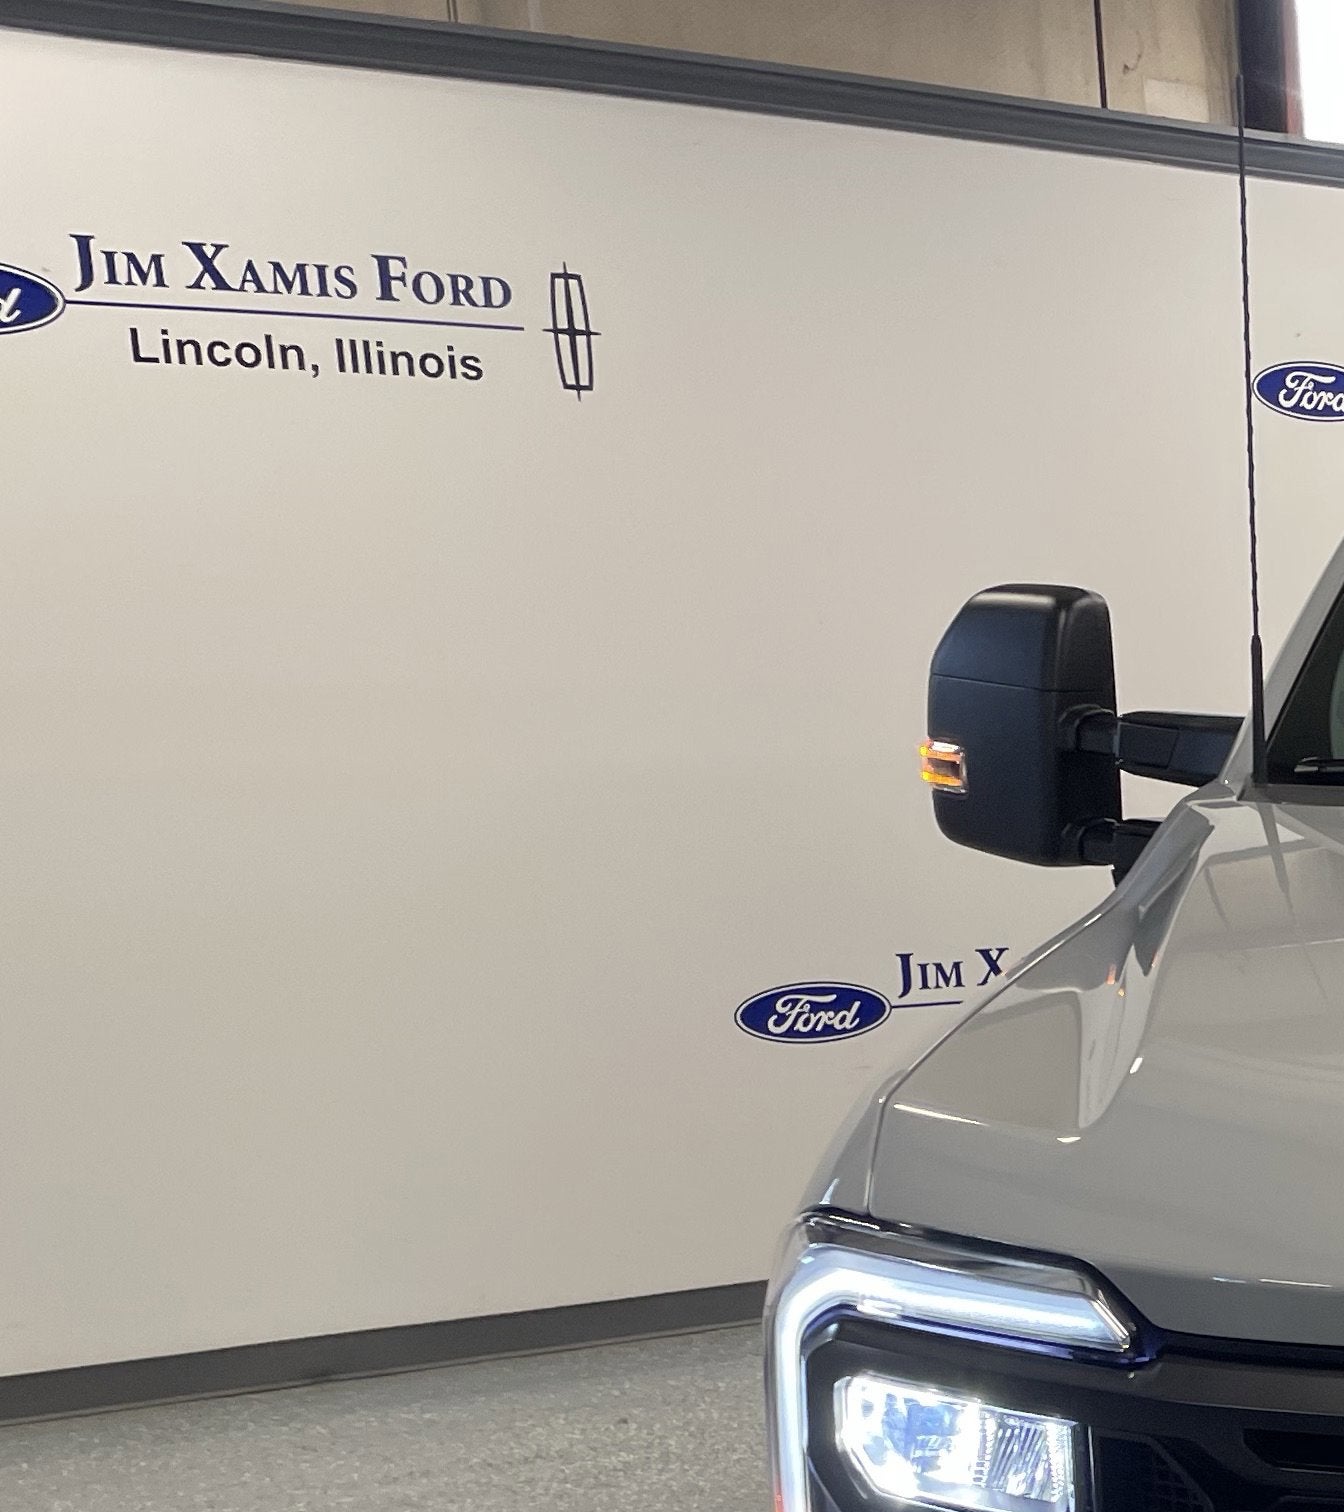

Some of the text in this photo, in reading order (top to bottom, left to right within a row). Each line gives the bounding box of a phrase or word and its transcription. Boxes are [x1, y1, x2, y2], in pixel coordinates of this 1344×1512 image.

[68, 233, 513, 310] JIM XAMIS FORD
[128, 326, 484, 381] Lincoln, Illinois
[895, 952, 965, 999] JIM
[767, 994, 861, 1034] Ford
